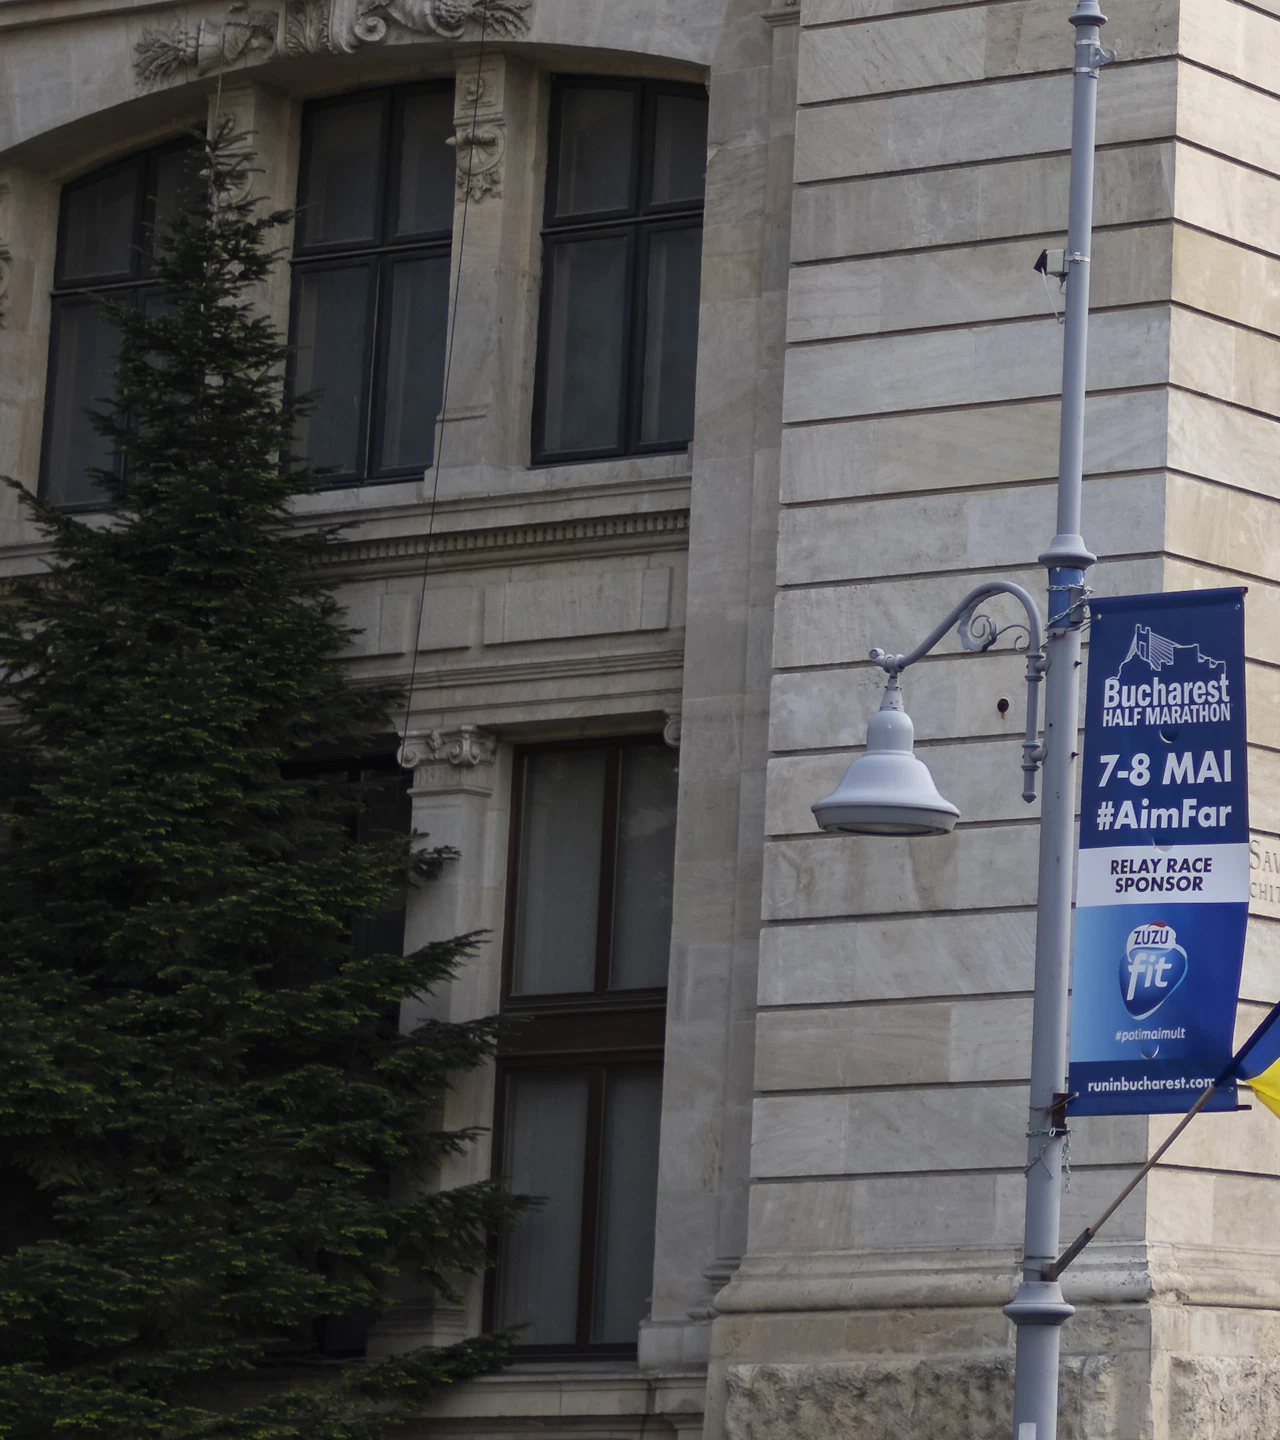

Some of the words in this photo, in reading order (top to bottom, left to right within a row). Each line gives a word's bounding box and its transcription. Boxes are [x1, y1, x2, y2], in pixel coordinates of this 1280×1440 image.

[1104, 674, 1230, 708] Bucharest
[1103, 707, 1142, 727] HALF
[1145, 703, 1231, 725] MARATHON
[1099, 753, 1150, 787] 7-8
[1162, 750, 1232, 785] MAI
[1097, 798, 1232, 830] #AimFar
[1110, 858, 1162, 875] RELAY
[1166, 857, 1213, 873] RACE
[1115, 876, 1204, 893] SPONSOR
[1133, 930, 1169, 946] ZUZU
[1126, 953, 1172, 1001] fit
[1115, 1027, 1186, 1043] #potimaimult
[1088, 1076, 1215, 1093] runinbucharest.com
